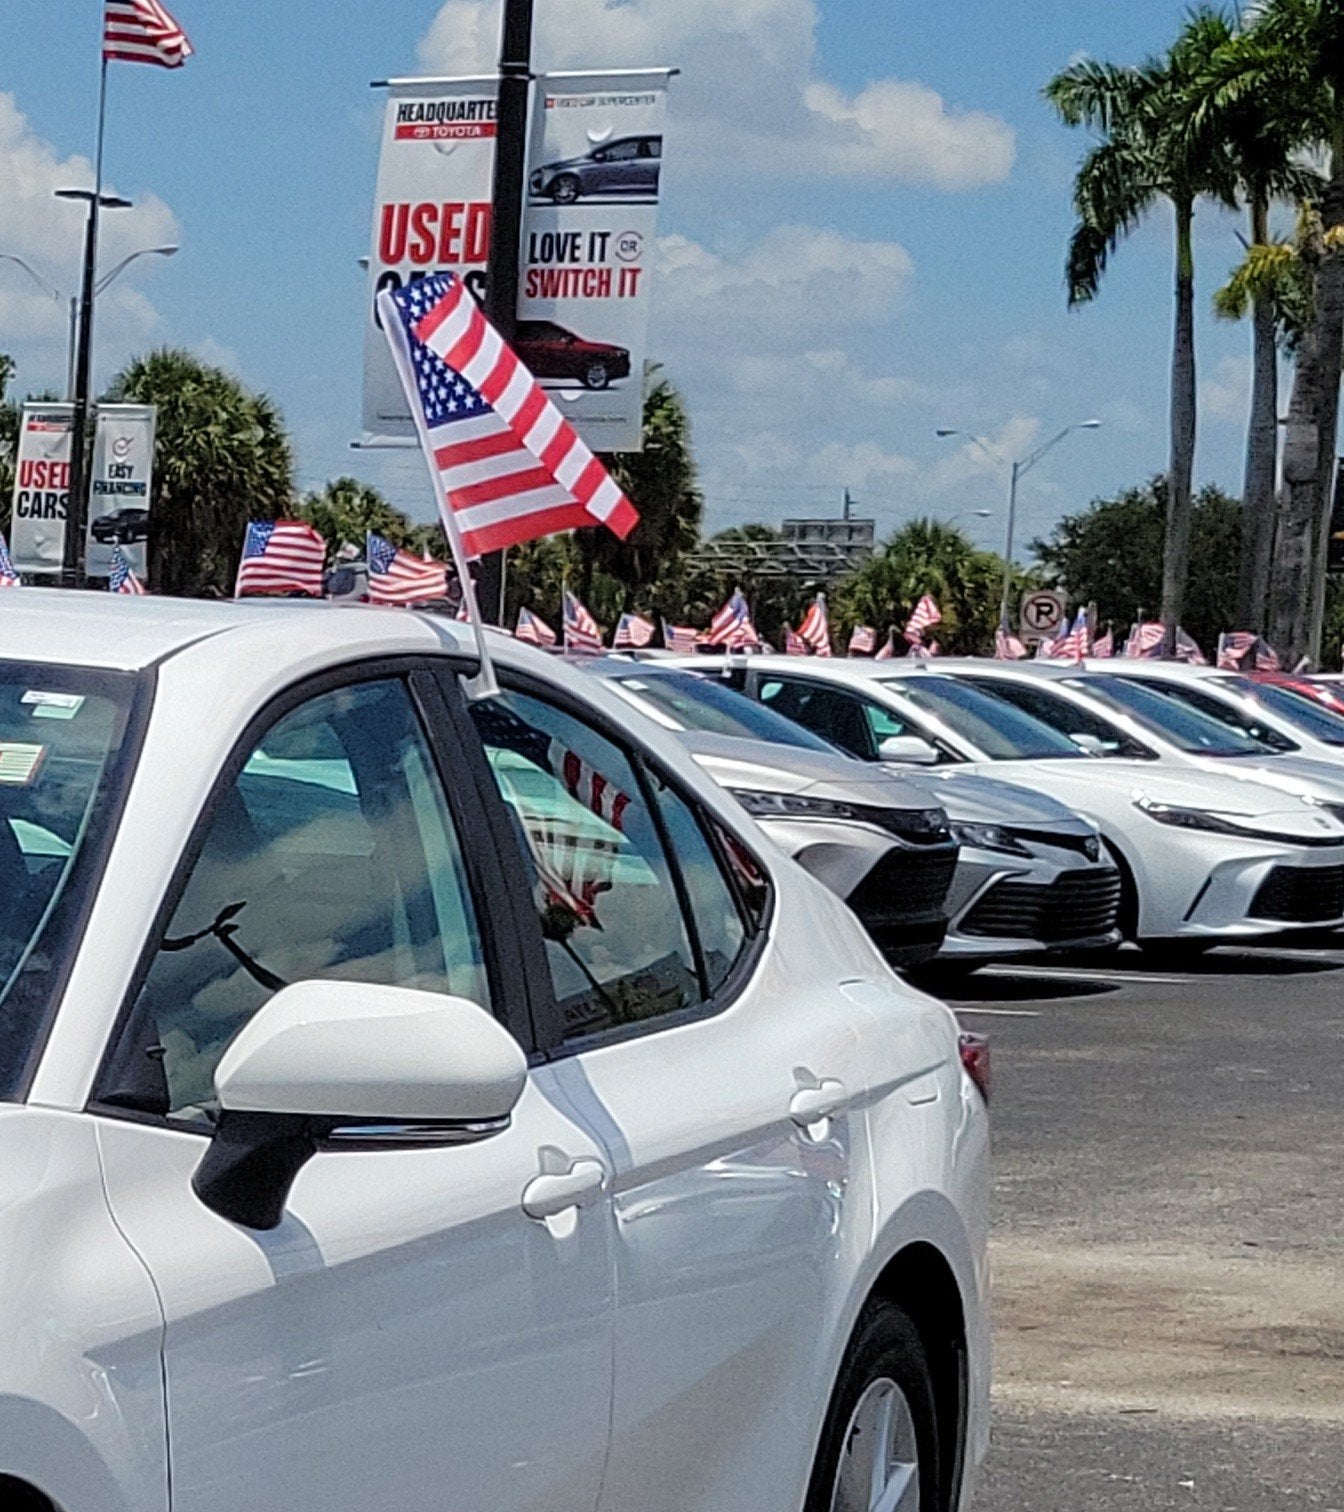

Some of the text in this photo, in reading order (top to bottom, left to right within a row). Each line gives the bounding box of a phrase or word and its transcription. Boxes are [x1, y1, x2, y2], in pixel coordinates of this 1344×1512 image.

[397, 100, 497, 124] HEADQUARTE
[433, 126, 481, 138] TOYOTA
[379, 203, 492, 264] USED
[529, 231, 638, 264] LOVE IT OR
[525, 267, 642, 299] SWITCH IT
